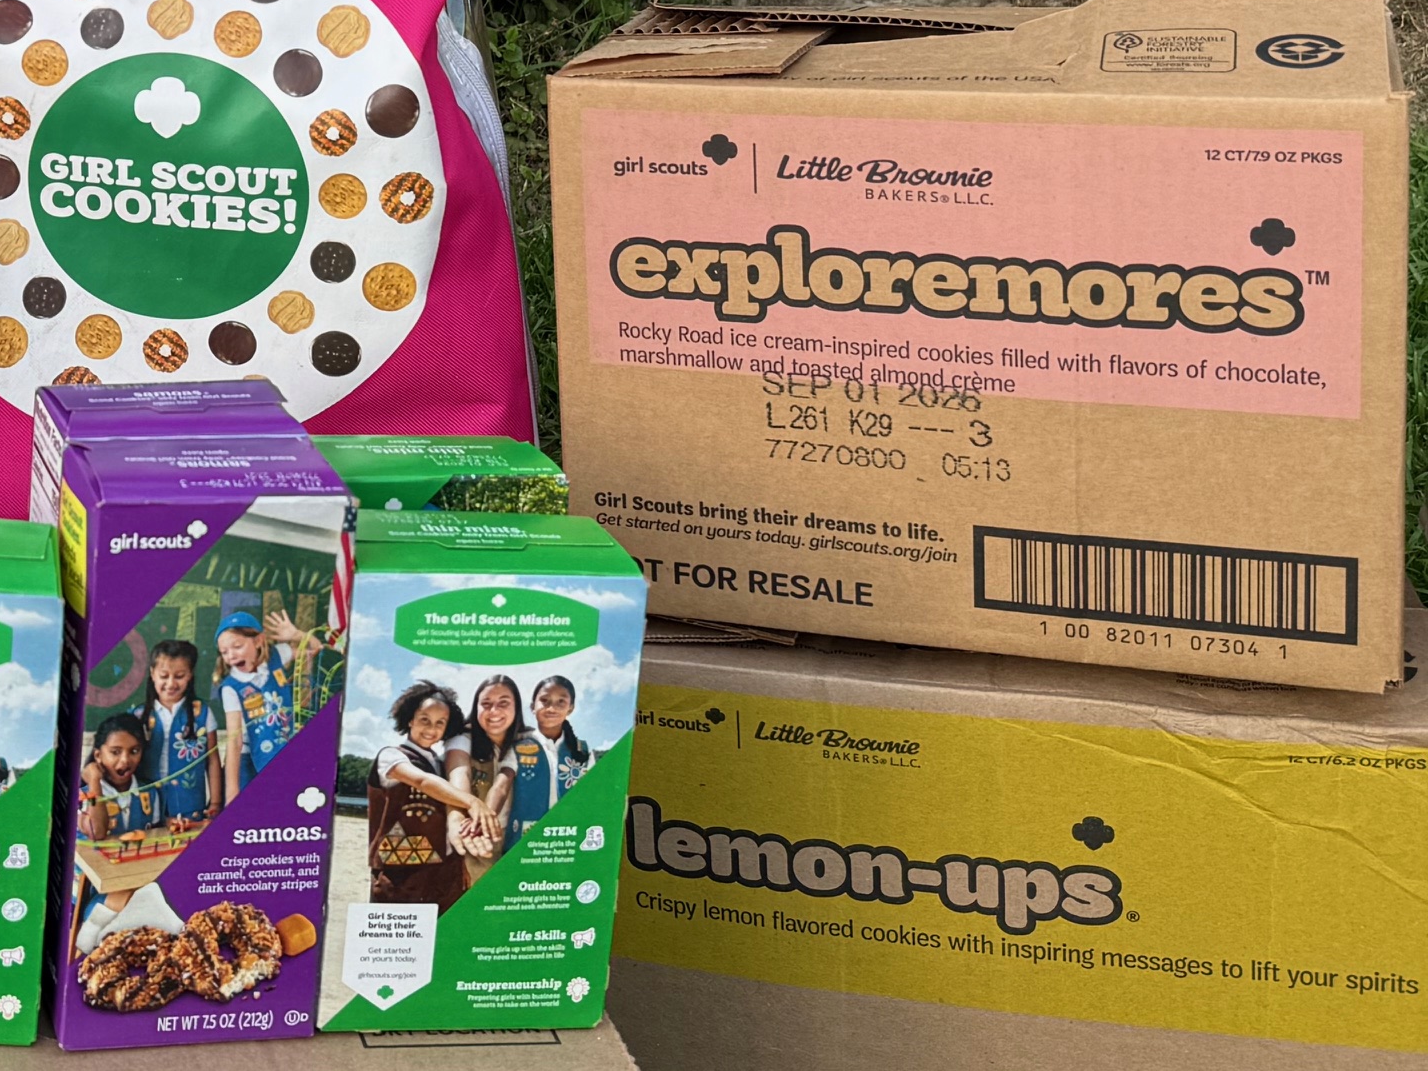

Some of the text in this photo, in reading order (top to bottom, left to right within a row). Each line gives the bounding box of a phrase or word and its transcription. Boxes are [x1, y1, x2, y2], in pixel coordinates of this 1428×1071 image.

[613, 156, 708, 176] girl scouts
[1204, 149, 1221, 161] 12
[1274, 151, 1297, 163] OZ
[1301, 152, 1343, 164] PKGS
[39, 152, 297, 196] GIRL SCOUT
[776, 154, 993, 188] Little Brownie
[39, 182, 298, 235] COOKIES!
[953, 192, 994, 206] L.L.C.
[609, 224, 1305, 336] exploremores
[619, 321, 1327, 390] Rocky Road ice cream-inspired cookies filled with flavors of chocolate,
[620, 346, 1016, 394] marshmallow and toasted almond crème
[765, 438, 1011, 481] 77270800 05:13
[594, 492, 944, 542] Girl Scouts bring their dreams to life.
[109, 532, 192, 555] girl scouts
[596, 512, 958, 564] Get started on yours today. girlscouts.org/join
[674, 562, 738, 591] FOR
[748, 569, 875, 607] RESALE
[424, 613, 571, 626] The Girl Scout Mission
[1064, 623, 1259, 656] 00 82011 07304
[658, 714, 711, 733] scouts
[754, 721, 920, 755] Little Brownie
[890, 757, 921, 769] L.L.C.
[543, 826, 577, 836] STEM
[221, 852, 320, 868] Crisp cookies with
[197, 865, 320, 881] caramel, coconut, and
[198, 879, 319, 894] dark chocolaty stripes
[518, 881, 572, 892] Outdoors
[509, 930, 566, 942] Life Skills
[635, 890, 1419, 995] Crispy lemon flavored cookies with inspiring messages to lift your spirits
[456, 979, 562, 992] Entrepreneurship
[157, 1016, 179, 1032] NET
[181, 1015, 200, 1031] WT
[219, 1013, 236, 1029] OZ
[238, 1010, 274, 1031] (212g)
